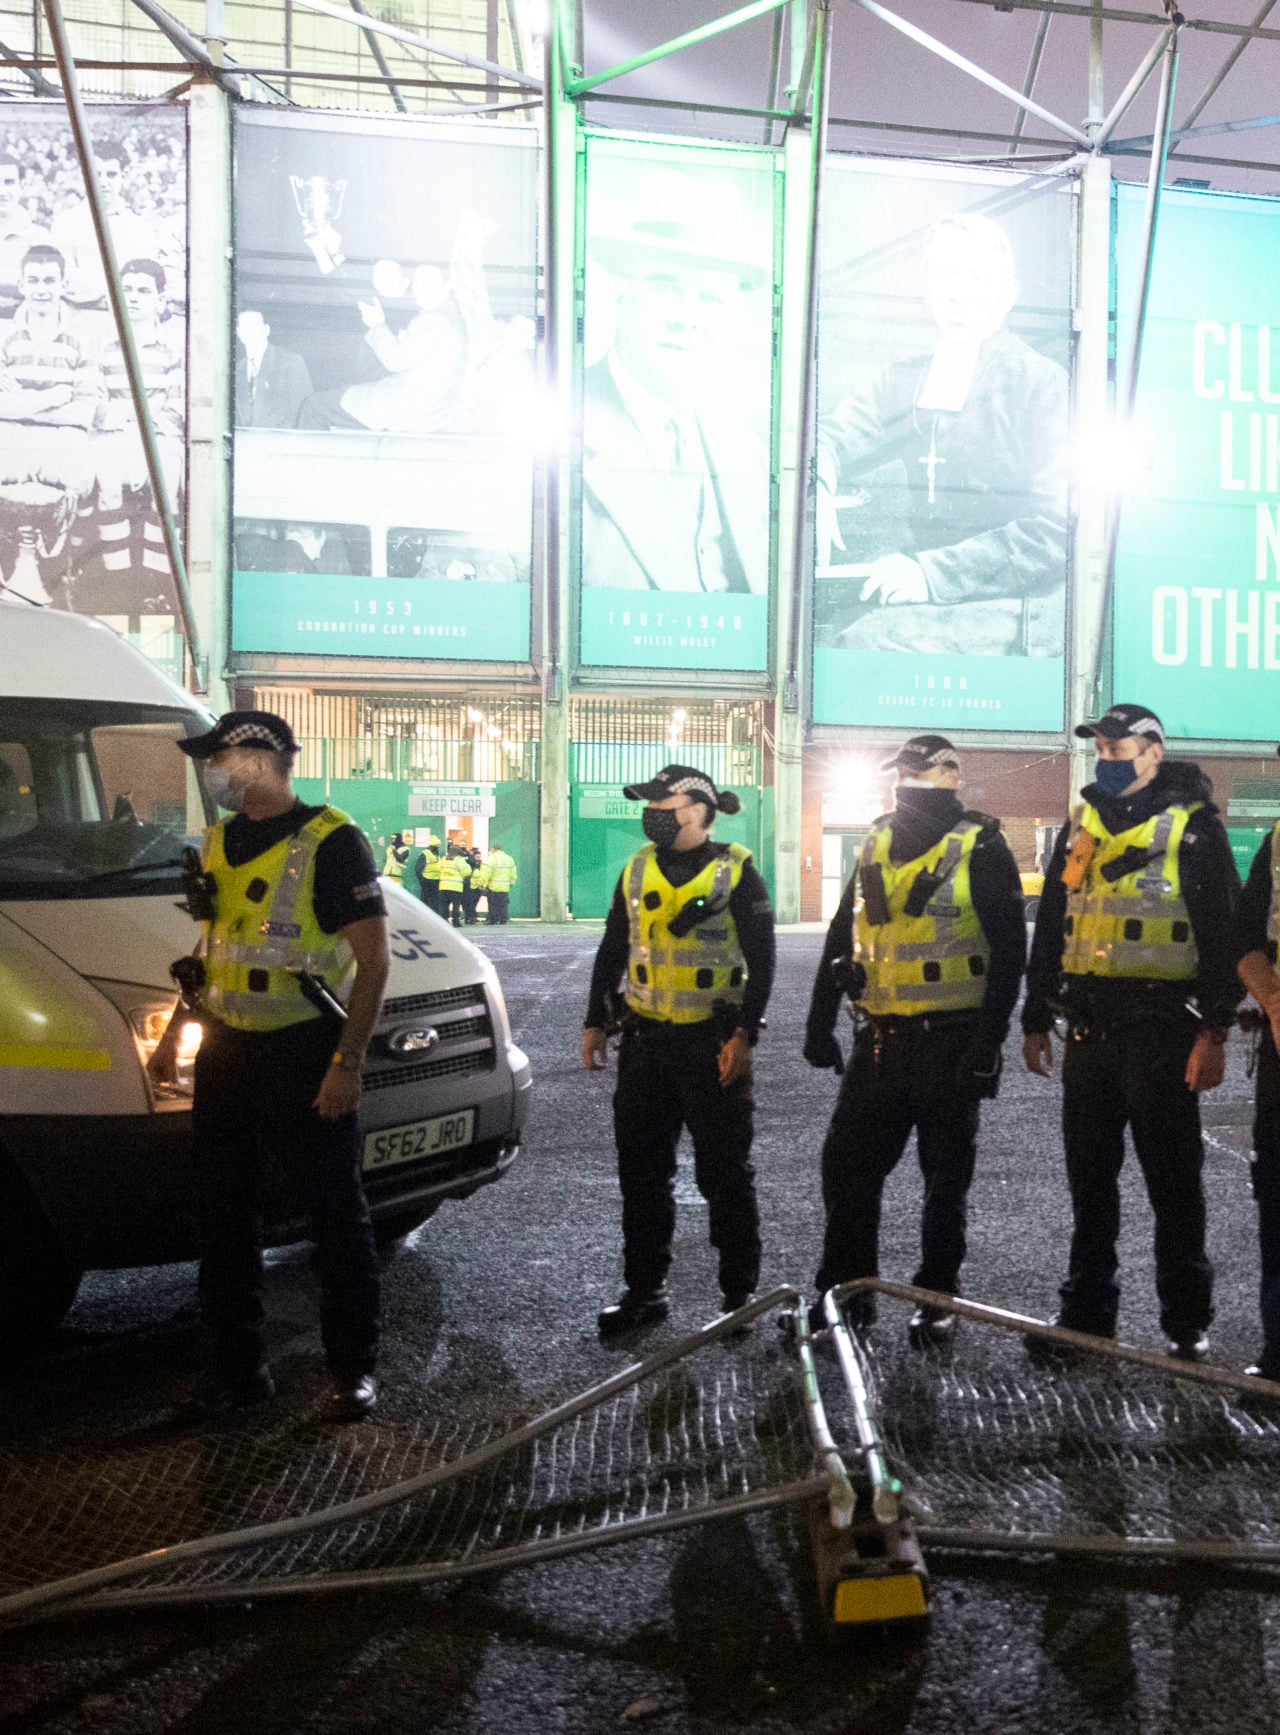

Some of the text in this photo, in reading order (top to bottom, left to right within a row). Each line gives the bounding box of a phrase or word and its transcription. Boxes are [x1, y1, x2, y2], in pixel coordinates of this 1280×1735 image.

[354, 599, 413, 617] 1953
[297, 620, 467, 638] CORONATION CUP WINNERS
[633, 634, 673, 647] WILLIE
[421, 798, 483, 814] KEEP CLEAR
[605, 801, 640, 816] GATE 2
[373, 1126, 427, 1164] SF62
